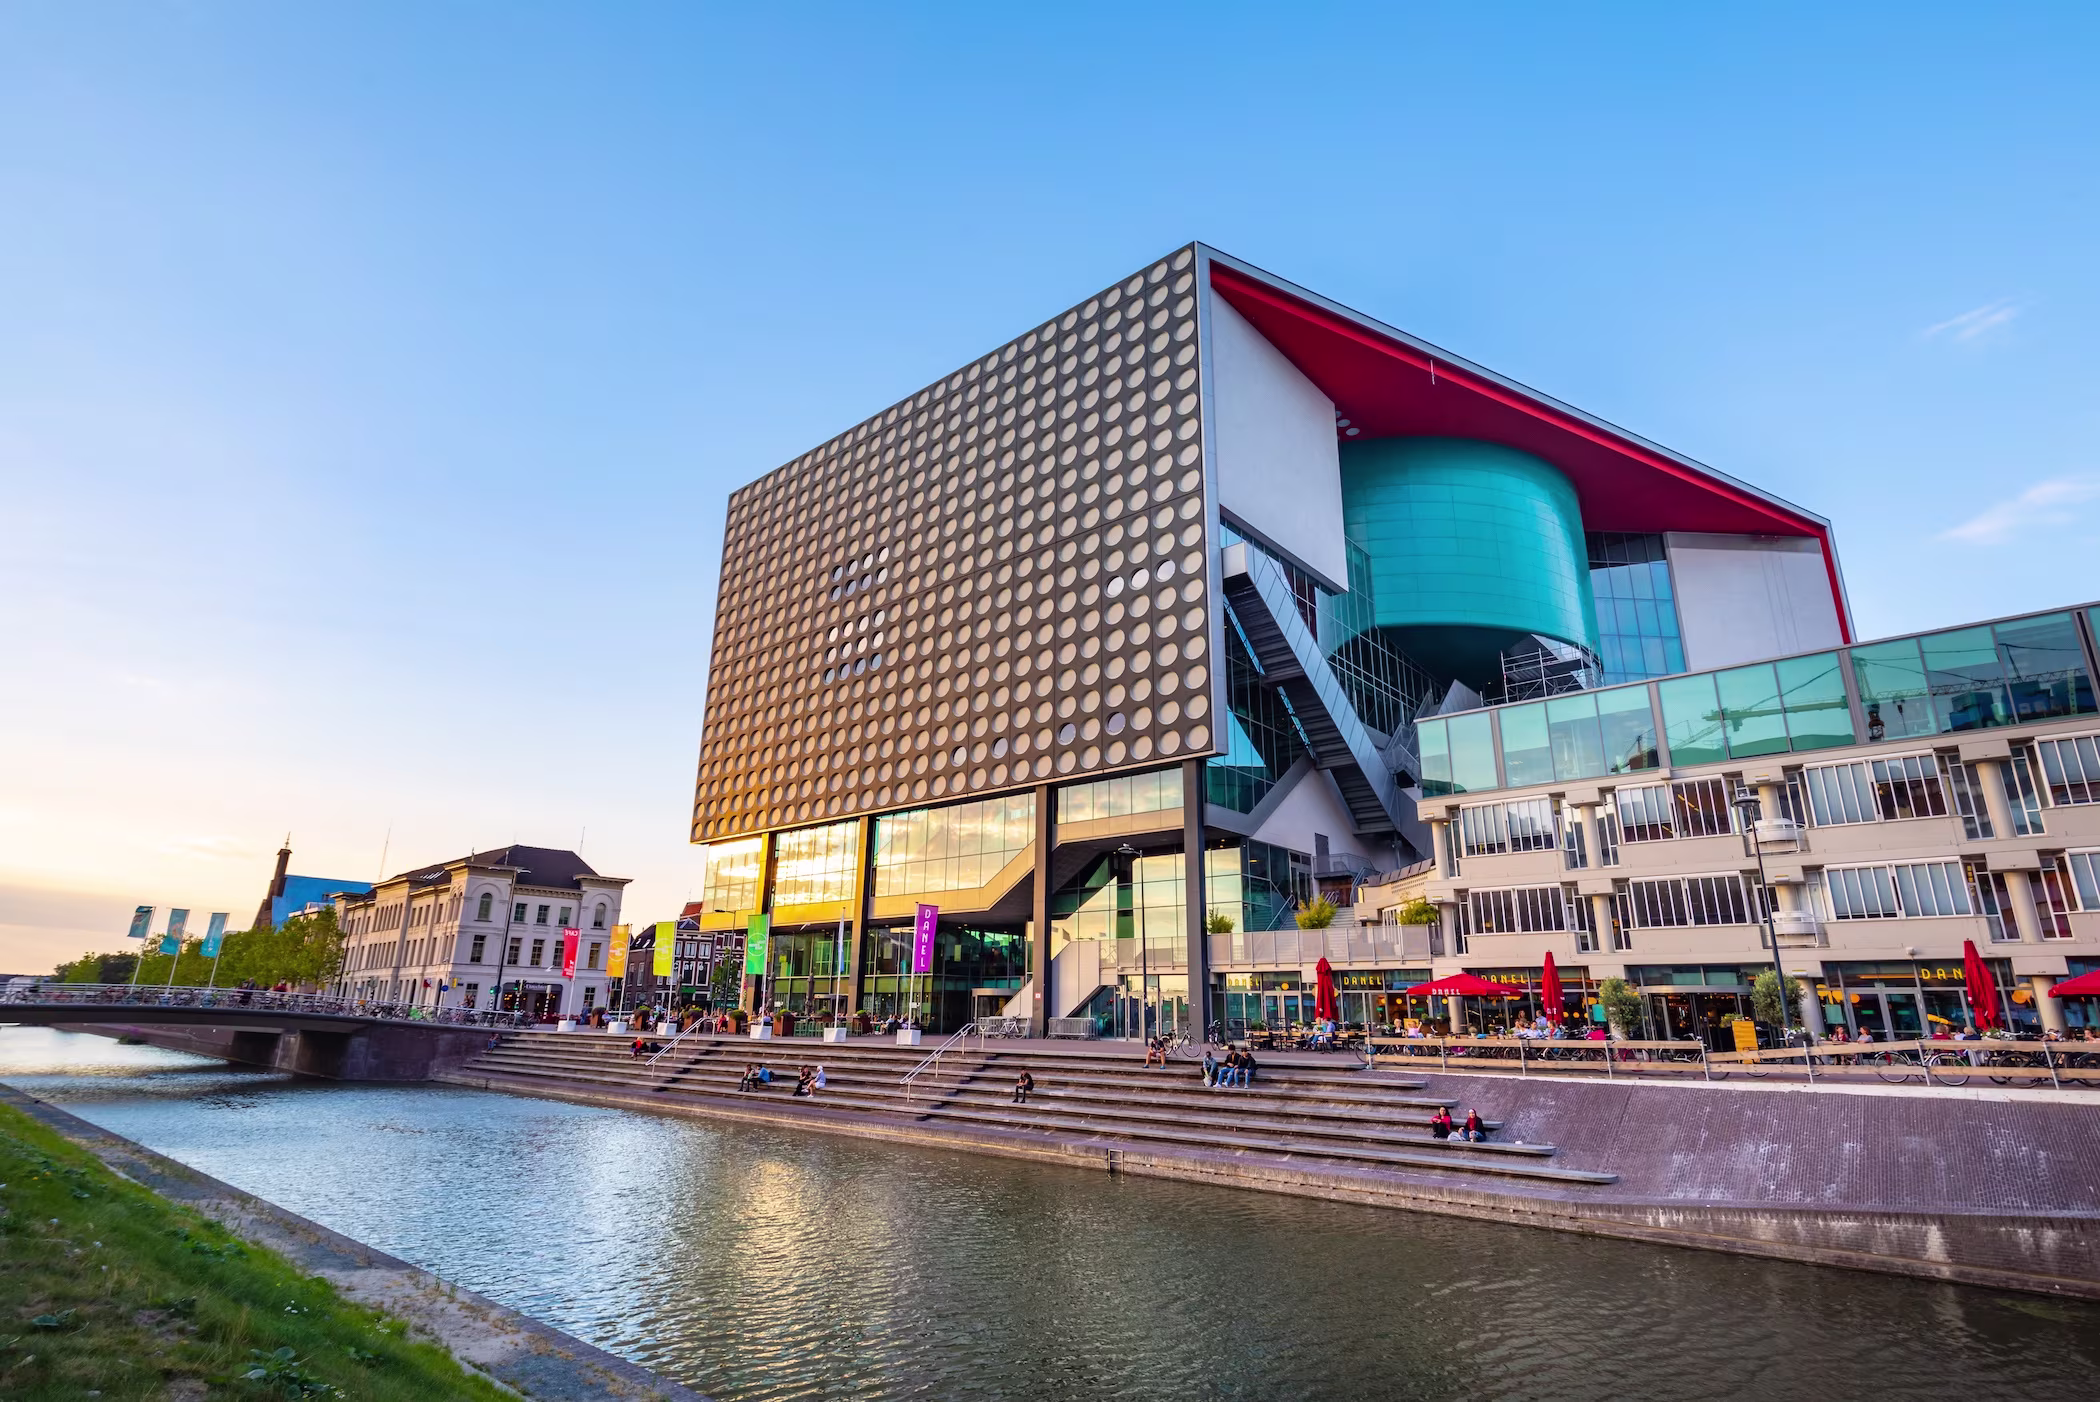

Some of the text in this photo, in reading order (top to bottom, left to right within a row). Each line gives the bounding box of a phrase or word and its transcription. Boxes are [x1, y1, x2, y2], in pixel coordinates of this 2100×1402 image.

[920, 909, 931, 967] DANEL
[1921, 968, 1963, 980] DAN
[1228, 978, 1259, 987] DANEL
[1343, 976, 1382, 985] DANEL
